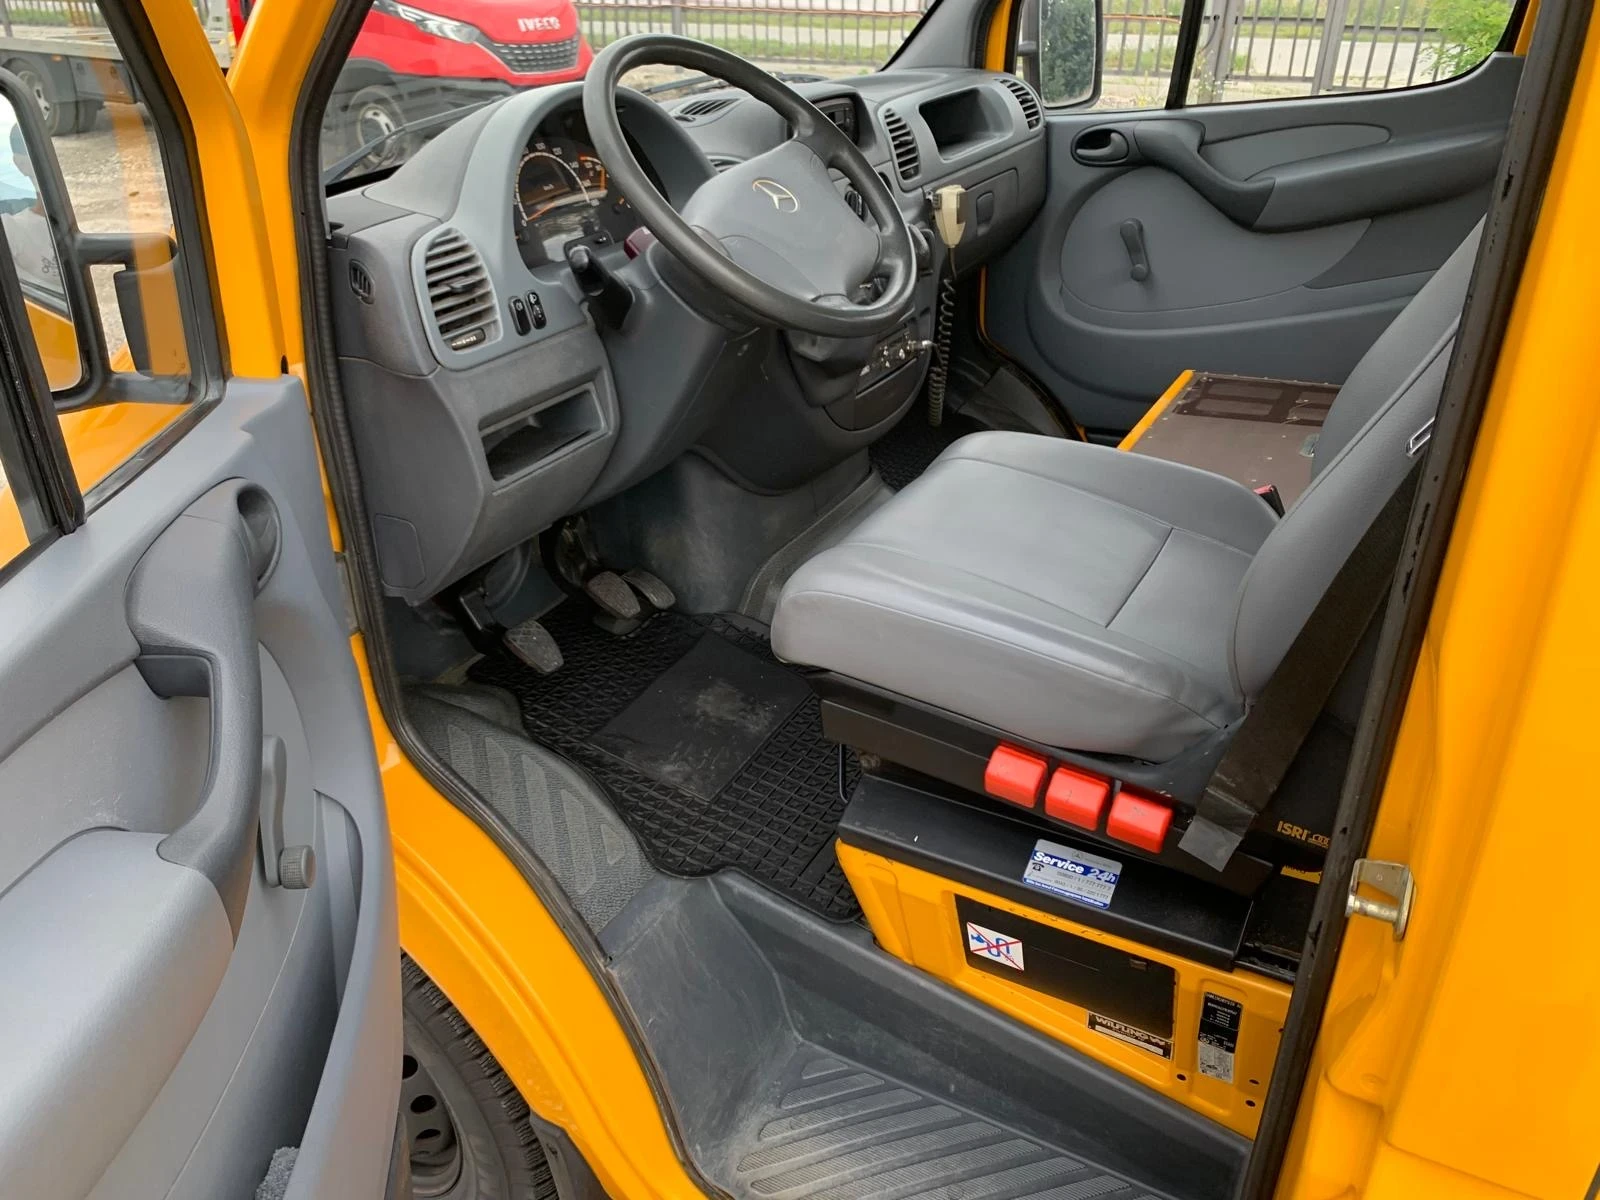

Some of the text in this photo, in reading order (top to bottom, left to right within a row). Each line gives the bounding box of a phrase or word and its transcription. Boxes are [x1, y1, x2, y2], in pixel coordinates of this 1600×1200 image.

[517, 16, 561, 32] IVECO
[1277, 820, 1308, 841] ISRI
[1033, 851, 1085, 874] Service
[1087, 868, 1116, 883] 24h
